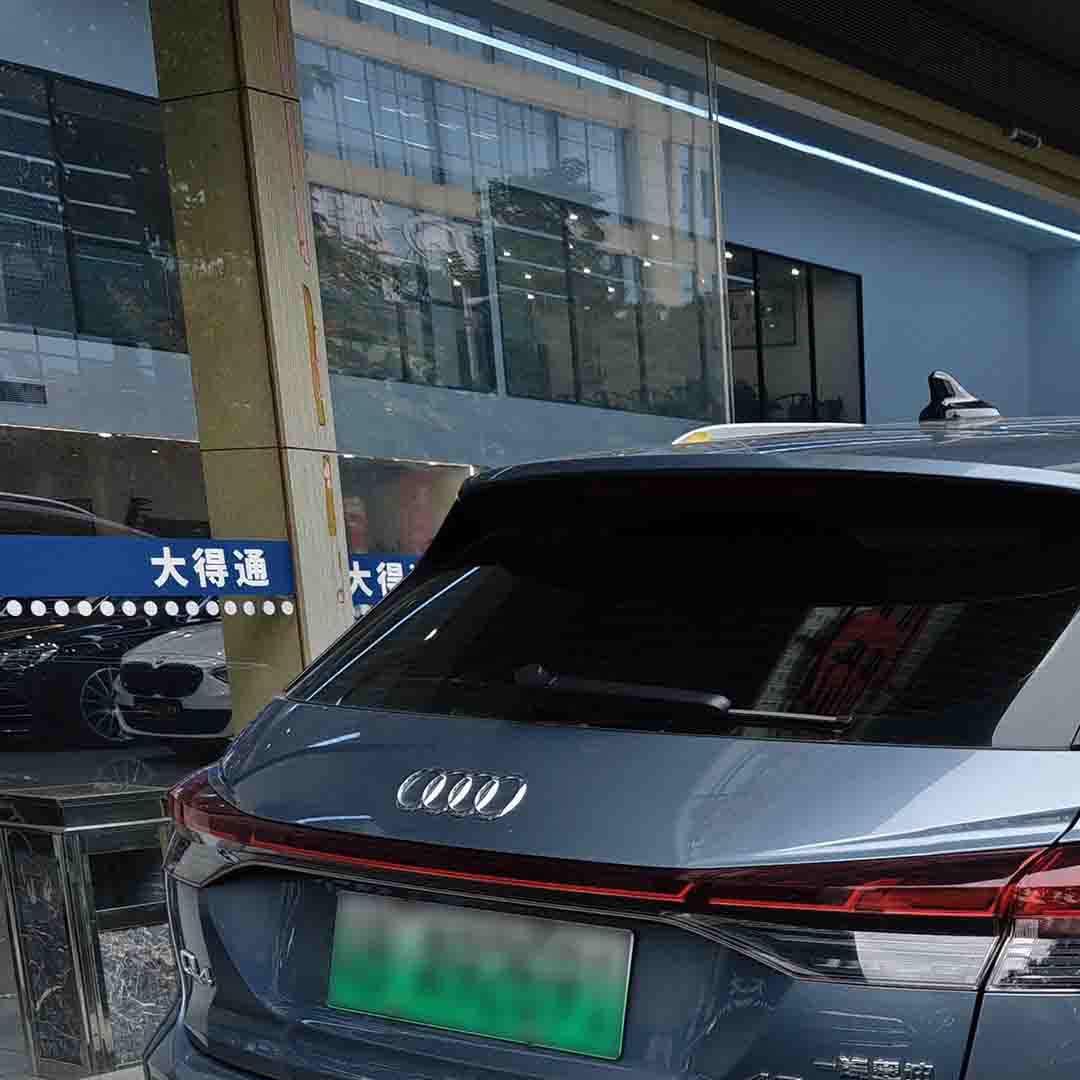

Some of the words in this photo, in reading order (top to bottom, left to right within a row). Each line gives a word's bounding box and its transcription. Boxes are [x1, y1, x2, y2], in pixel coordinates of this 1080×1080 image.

[151, 546, 270, 588] 大得通
[350, 560, 416, 597] 大得
[180, 949, 213, 984] Q4
